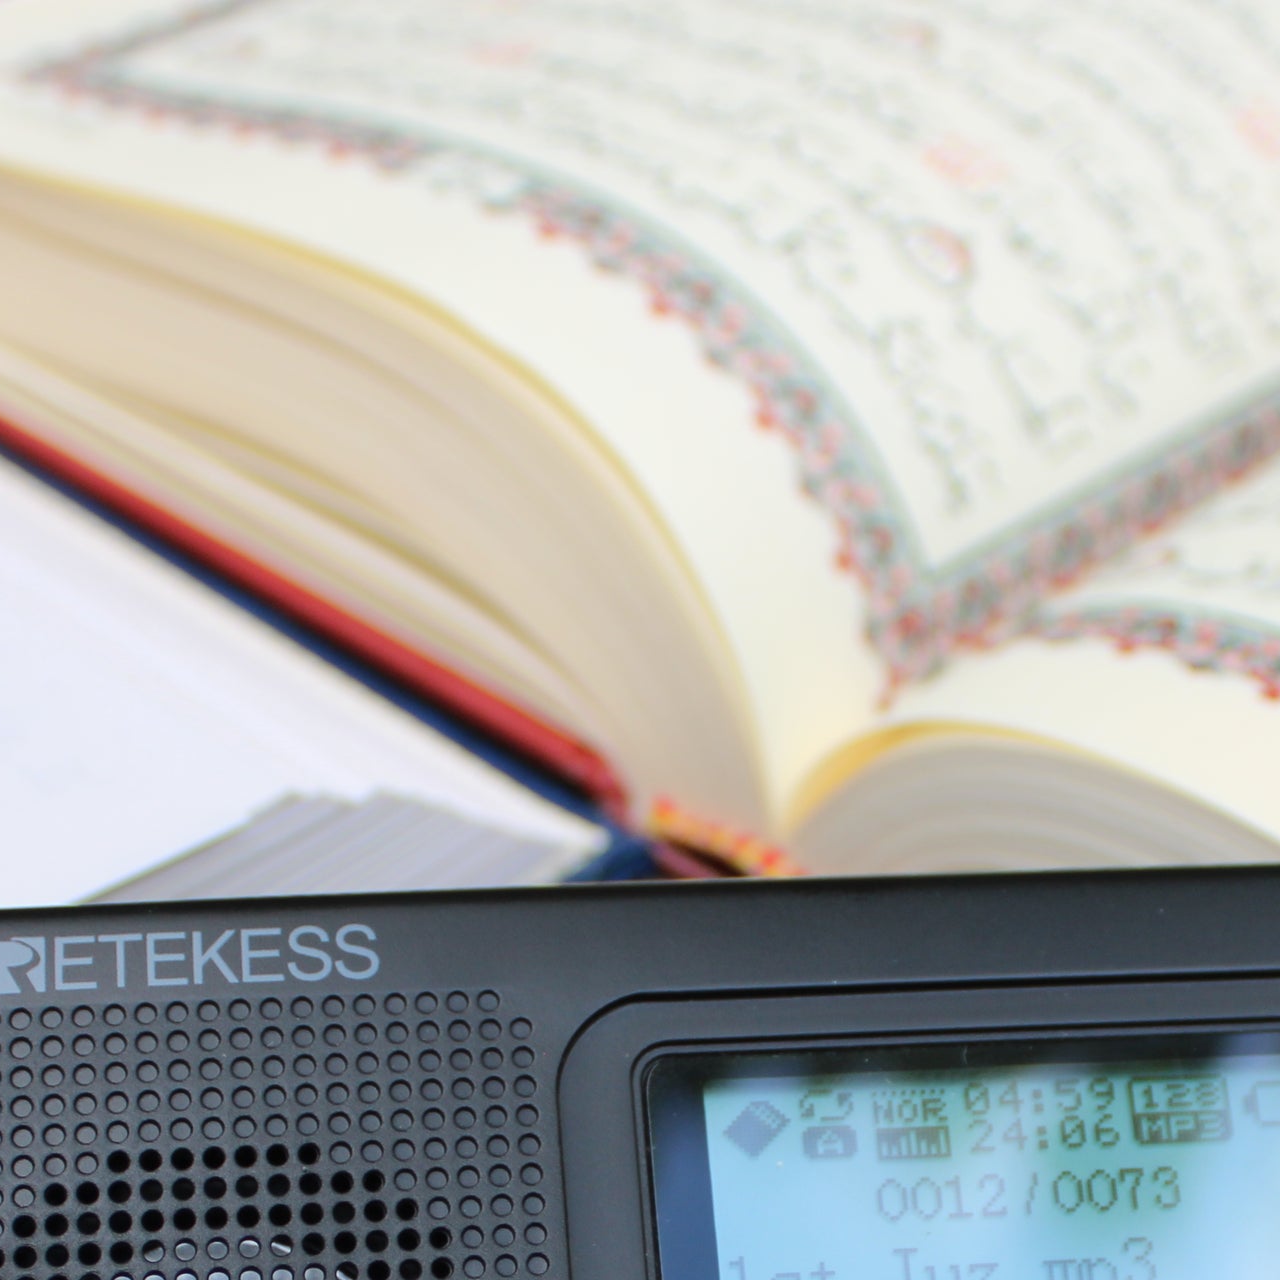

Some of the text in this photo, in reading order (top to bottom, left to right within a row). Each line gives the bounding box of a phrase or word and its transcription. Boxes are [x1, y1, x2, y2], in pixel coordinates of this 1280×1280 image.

[874, 1095, 949, 1124] NOR
[964, 1077, 1116, 1117] 04:59
[969, 1113, 1120, 1153] 24:06
[877, 1166, 1181, 1222] 0012/0073
